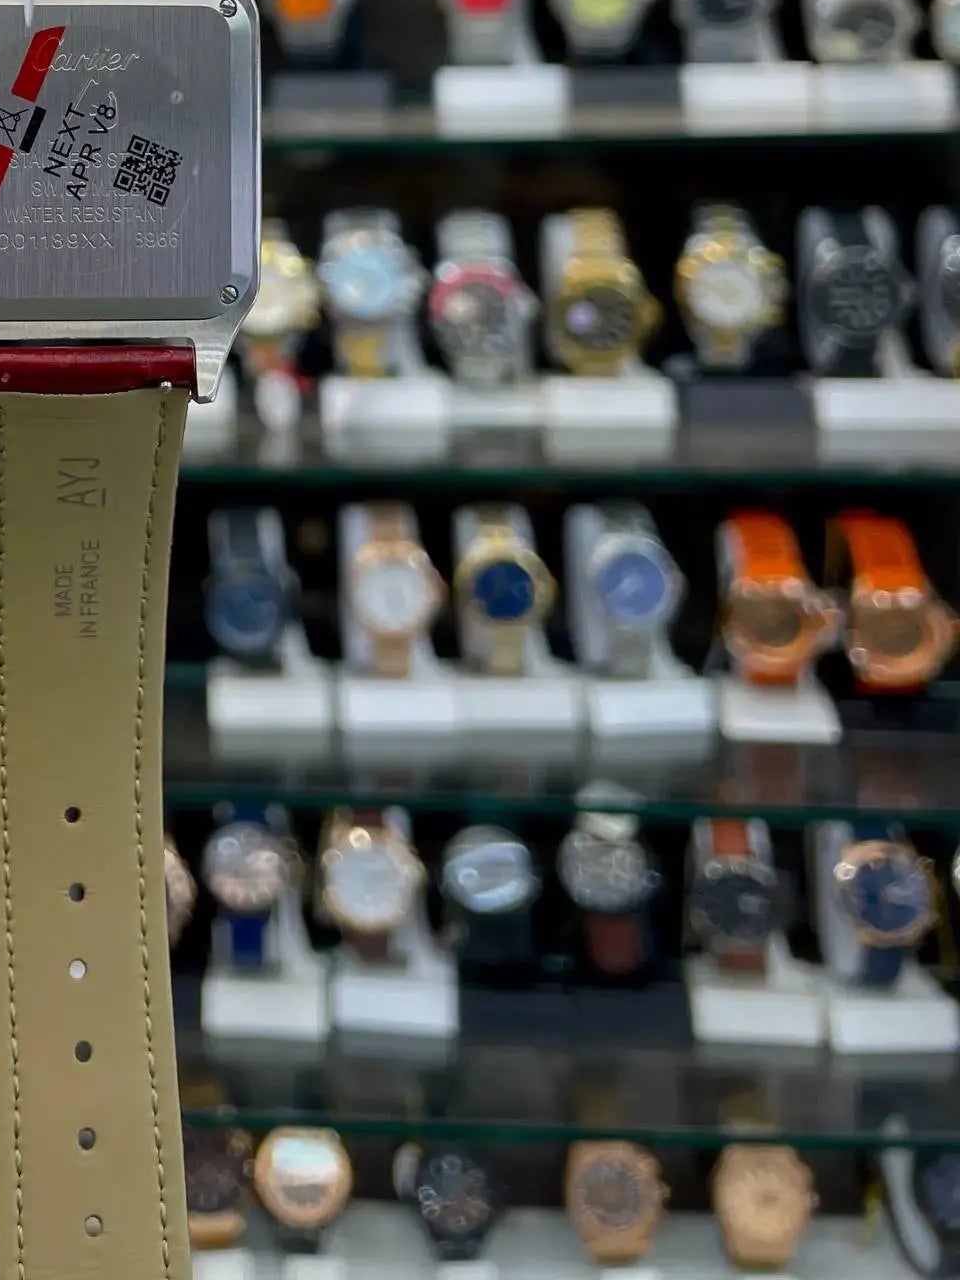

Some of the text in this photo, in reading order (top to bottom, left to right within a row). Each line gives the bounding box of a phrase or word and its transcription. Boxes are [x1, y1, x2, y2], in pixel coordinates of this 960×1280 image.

[32, 37, 140, 73] Cartier
[43, 102, 86, 178] NEXT
[66, 143, 101, 201] APR
[88, 103, 118, 136] V8
[5, 205, 167, 223] WATER RESISTANT
[56, 456, 102, 508] AYJ
[53, 563, 74, 617] MADE
[79, 539, 100, 638] IN FRANCE
